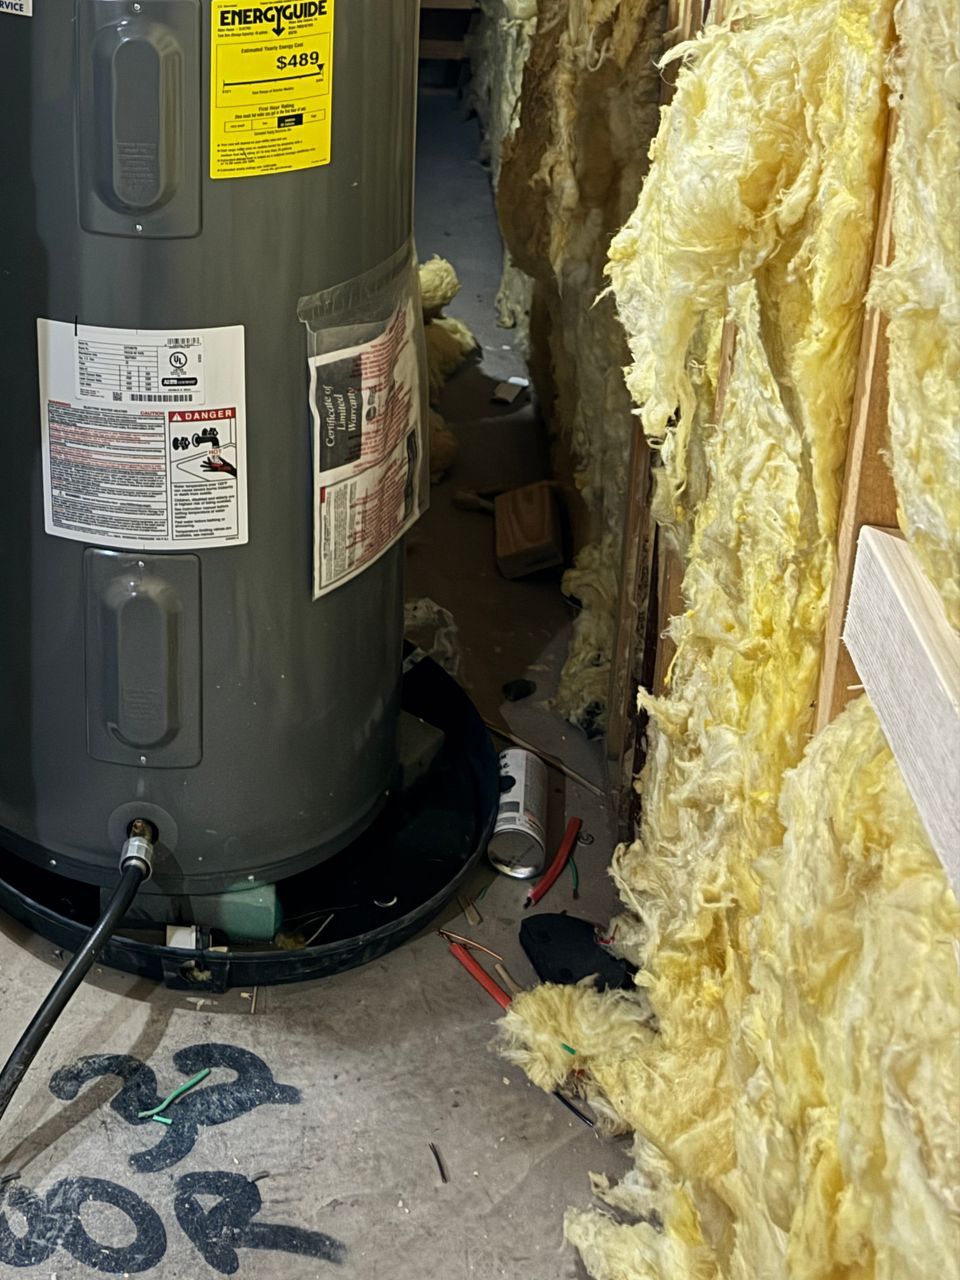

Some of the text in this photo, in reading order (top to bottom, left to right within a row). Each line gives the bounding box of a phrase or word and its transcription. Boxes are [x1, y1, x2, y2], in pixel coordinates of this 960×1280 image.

[220, 0, 327, 27] ENERGYGUIDE
[276, 51, 319, 71] $489
[185, 409, 232, 420] DANGER
[322, 384, 336, 447] Certificate of
[333, 393, 346, 431] Limited
[347, 386, 358, 432] Warranty
